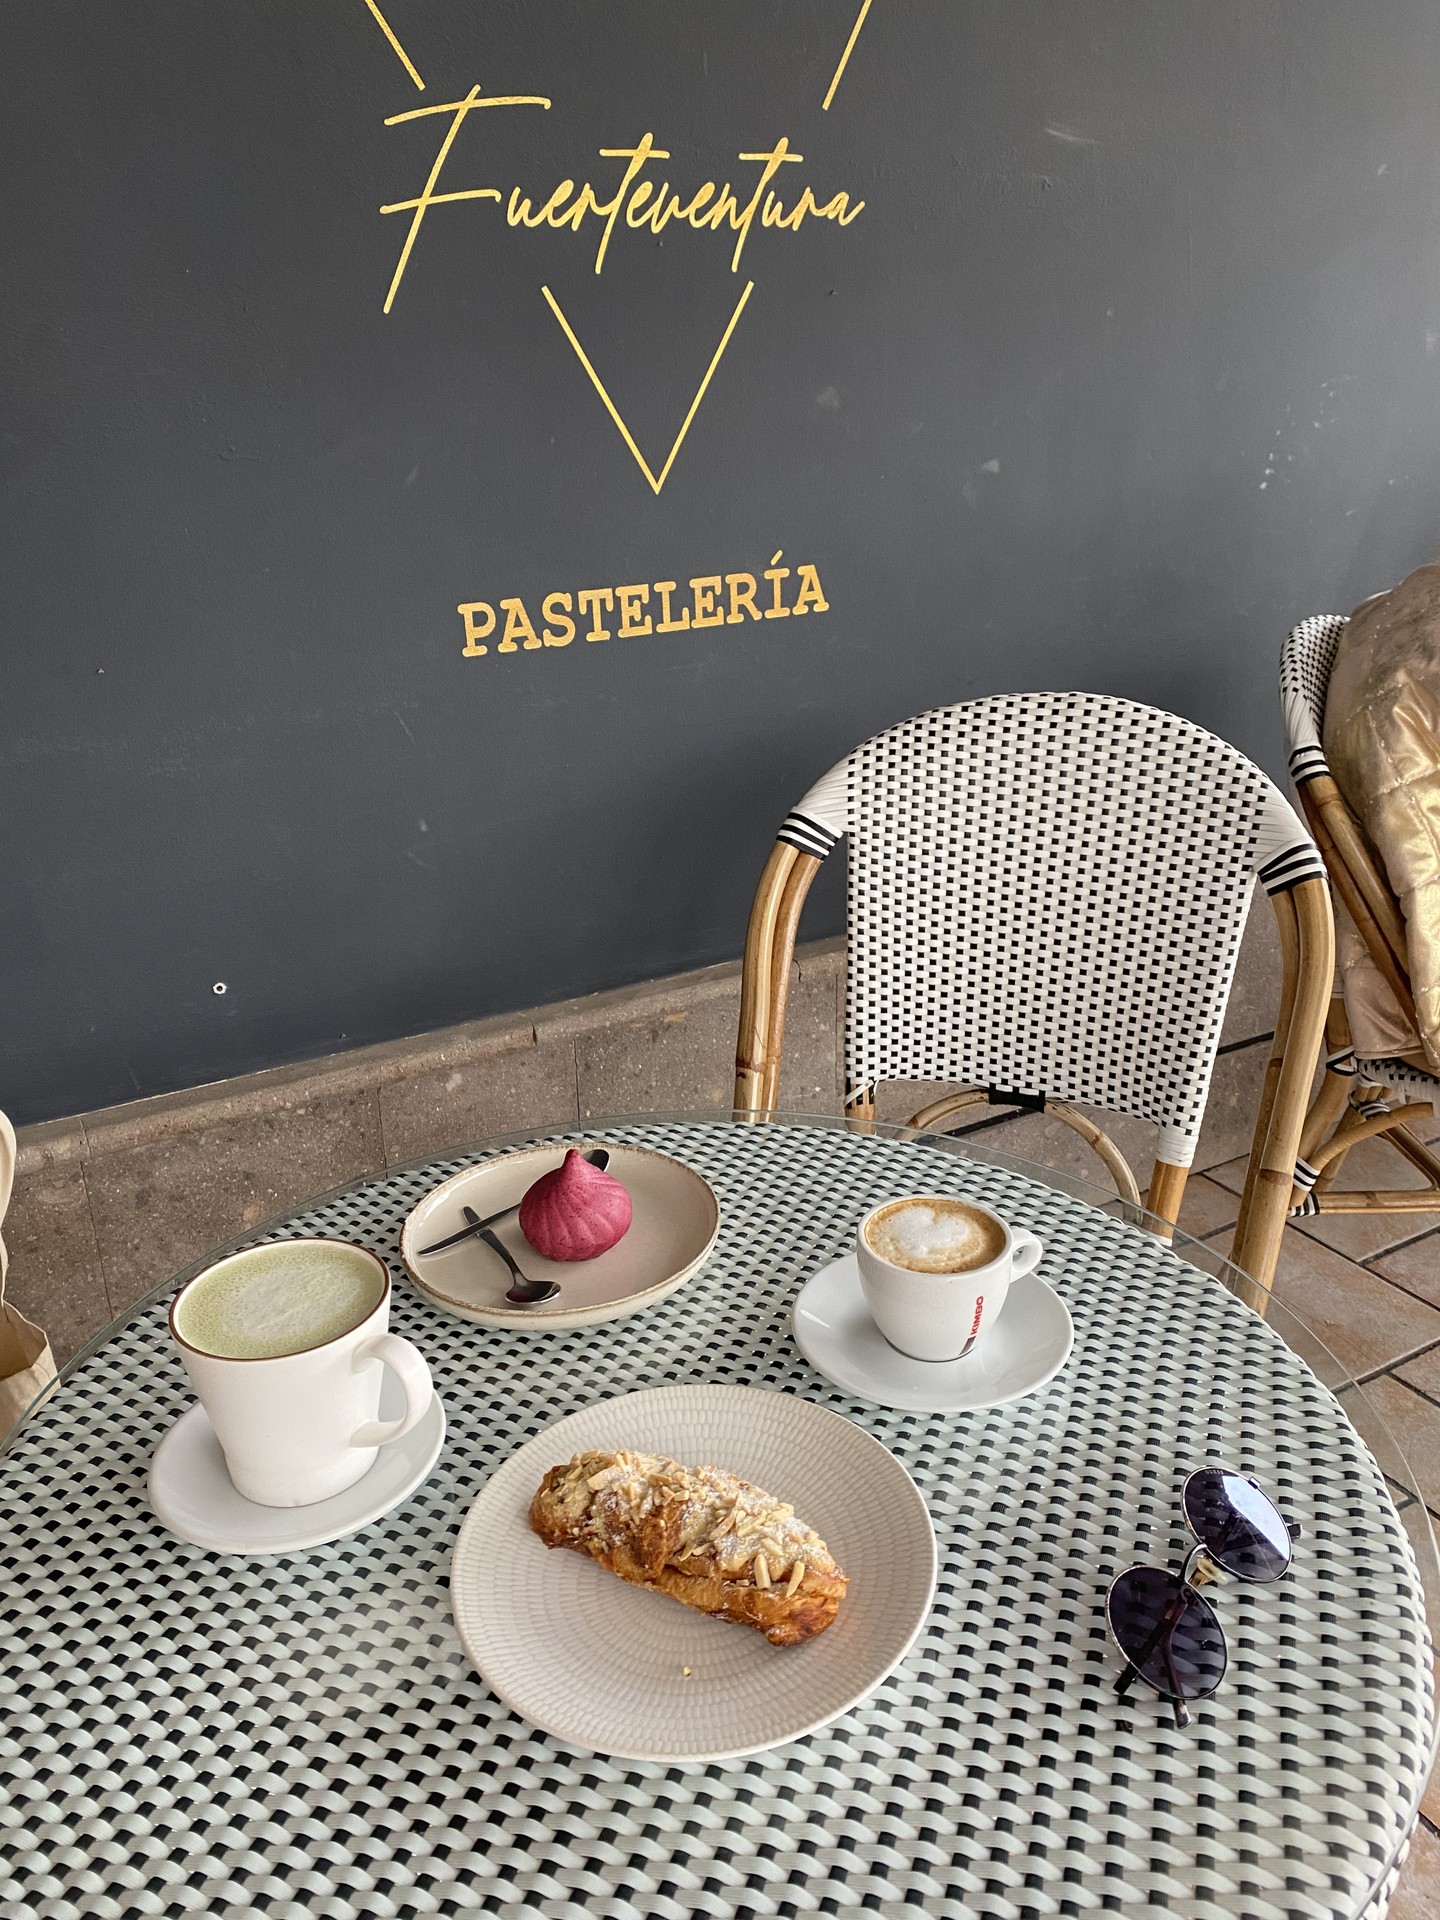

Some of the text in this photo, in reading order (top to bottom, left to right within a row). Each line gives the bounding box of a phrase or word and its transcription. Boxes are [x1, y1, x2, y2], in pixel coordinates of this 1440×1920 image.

[380, 84, 865, 314] Fuerteventura
[457, 551, 830, 657] PASTELERÍA
[970, 1296, 984, 1335] KIMBO
